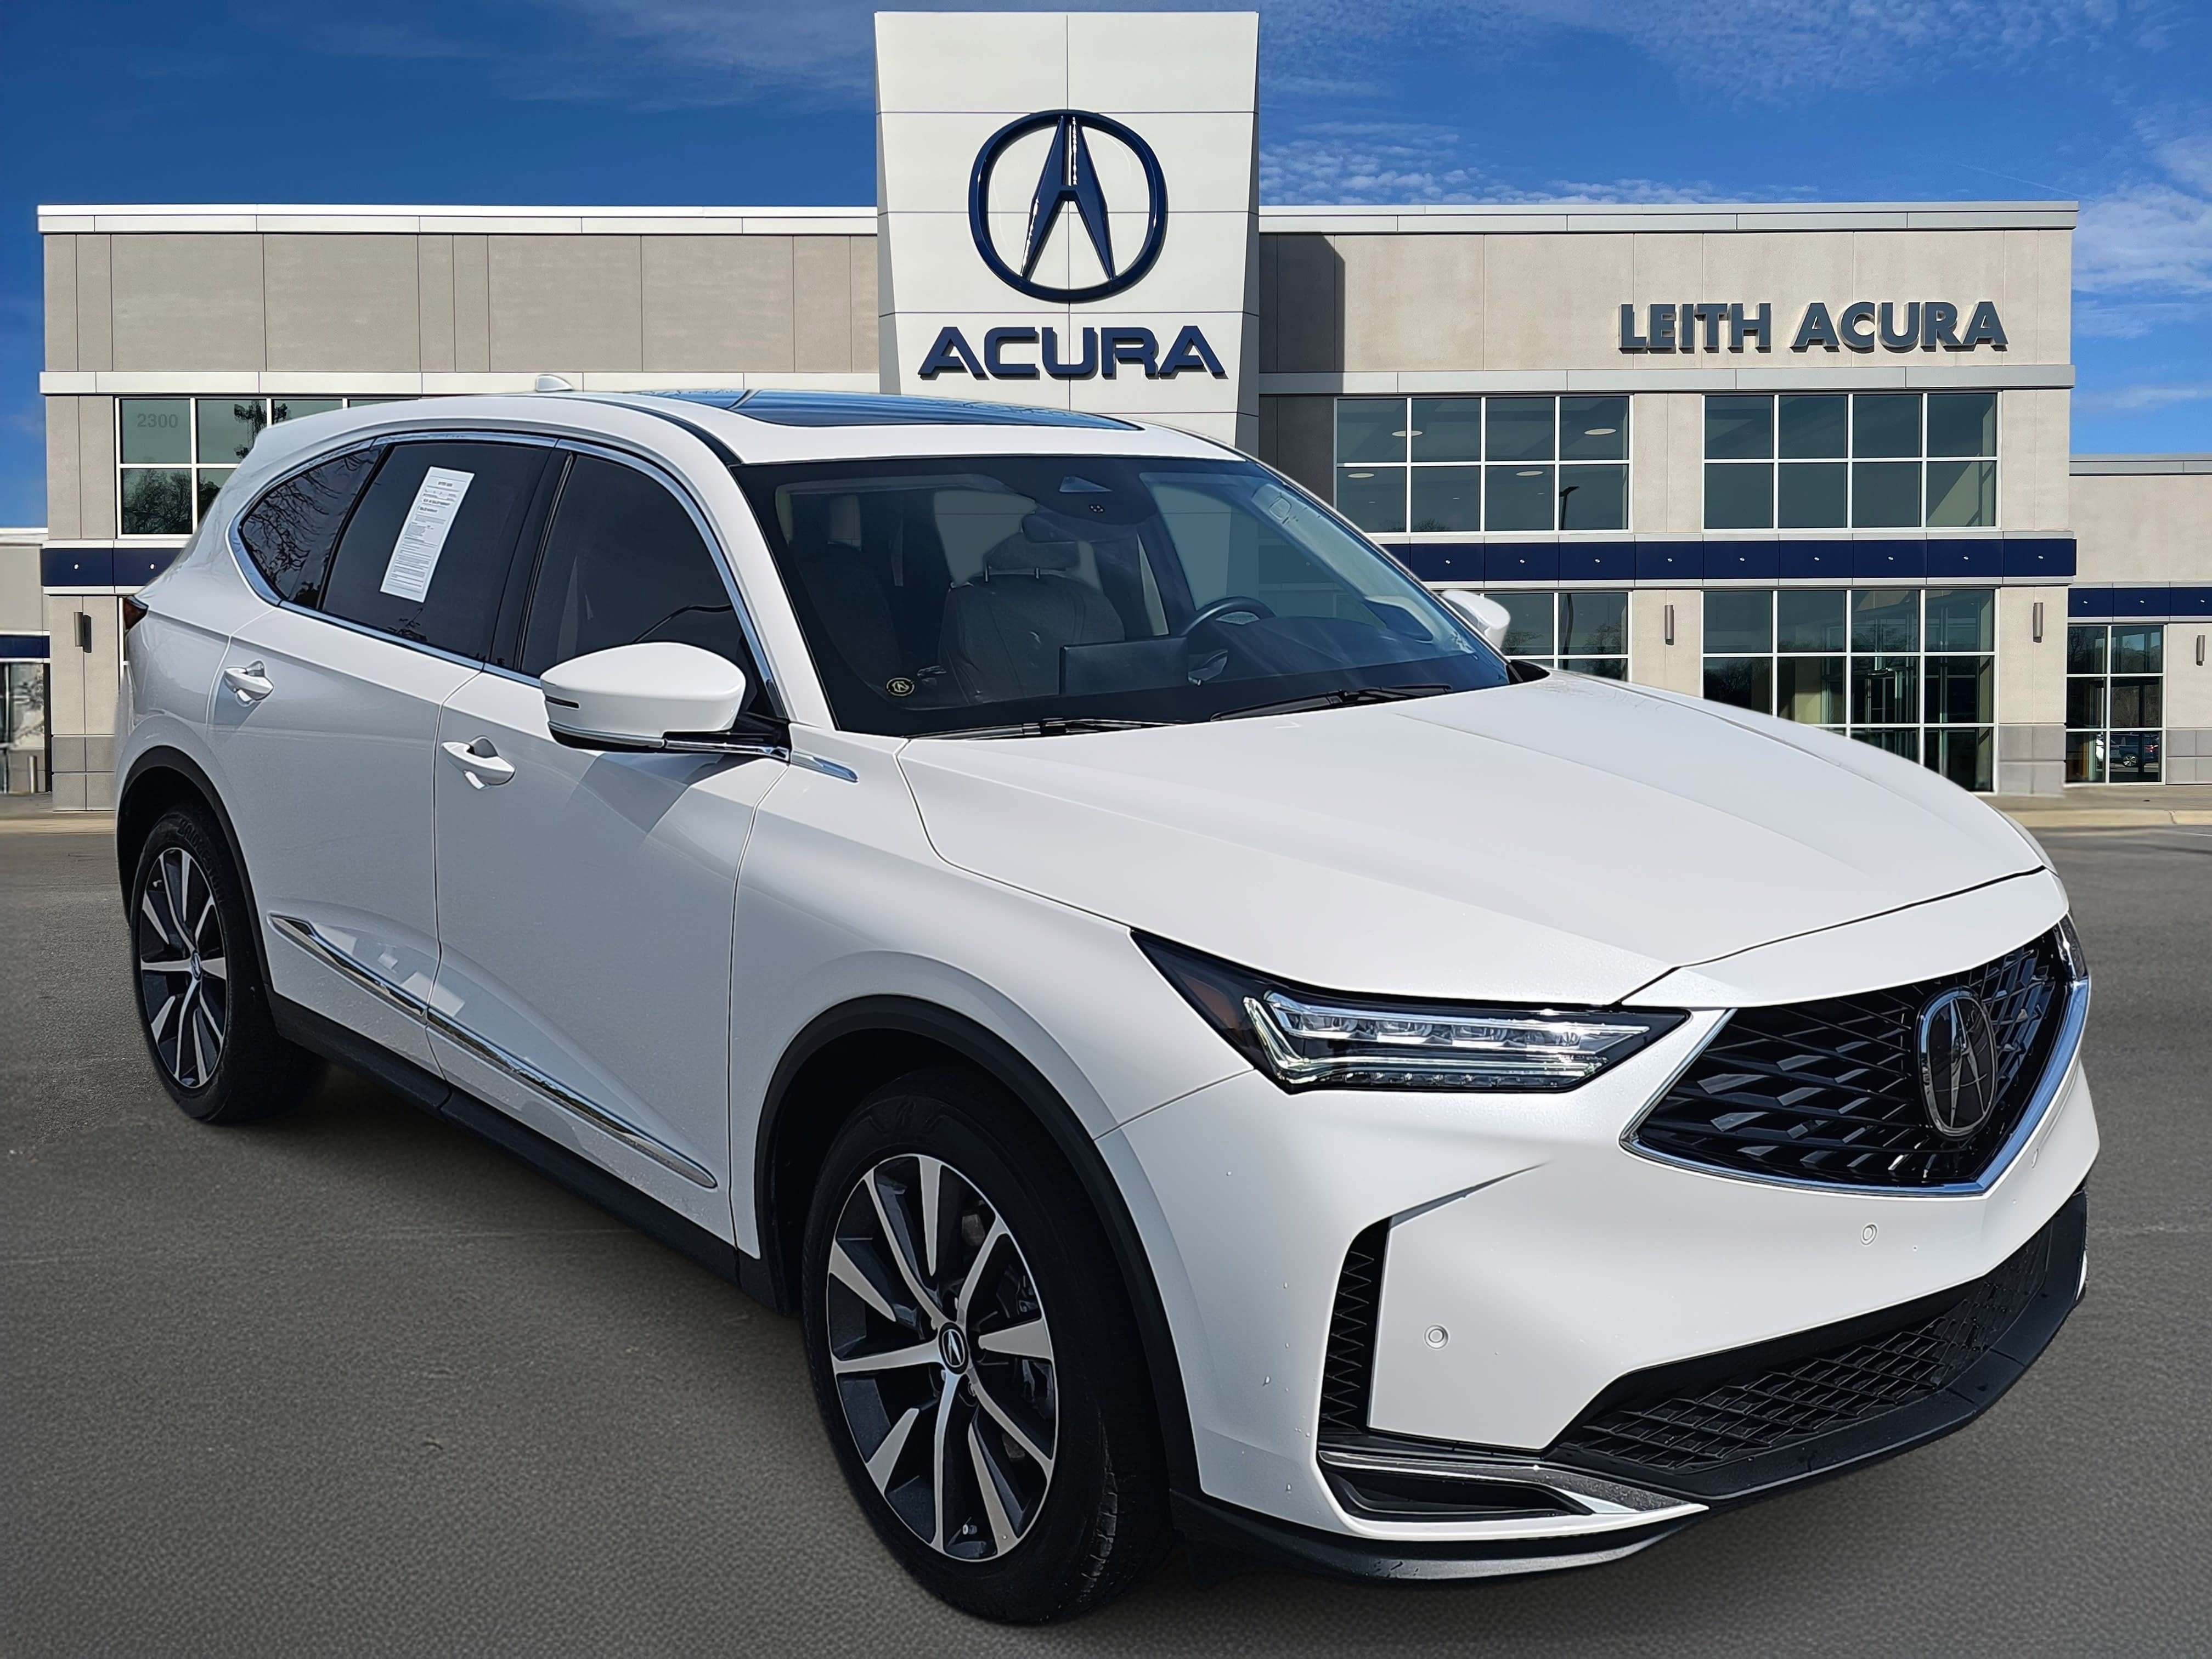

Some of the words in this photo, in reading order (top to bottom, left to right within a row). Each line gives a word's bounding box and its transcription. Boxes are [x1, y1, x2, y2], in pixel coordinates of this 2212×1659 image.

[918, 325, 1227, 379] ACURA
[1618, 302, 1771, 352] LEITH
[1790, 301, 2009, 352] ACURA
[137, 413, 178, 428] 2300
